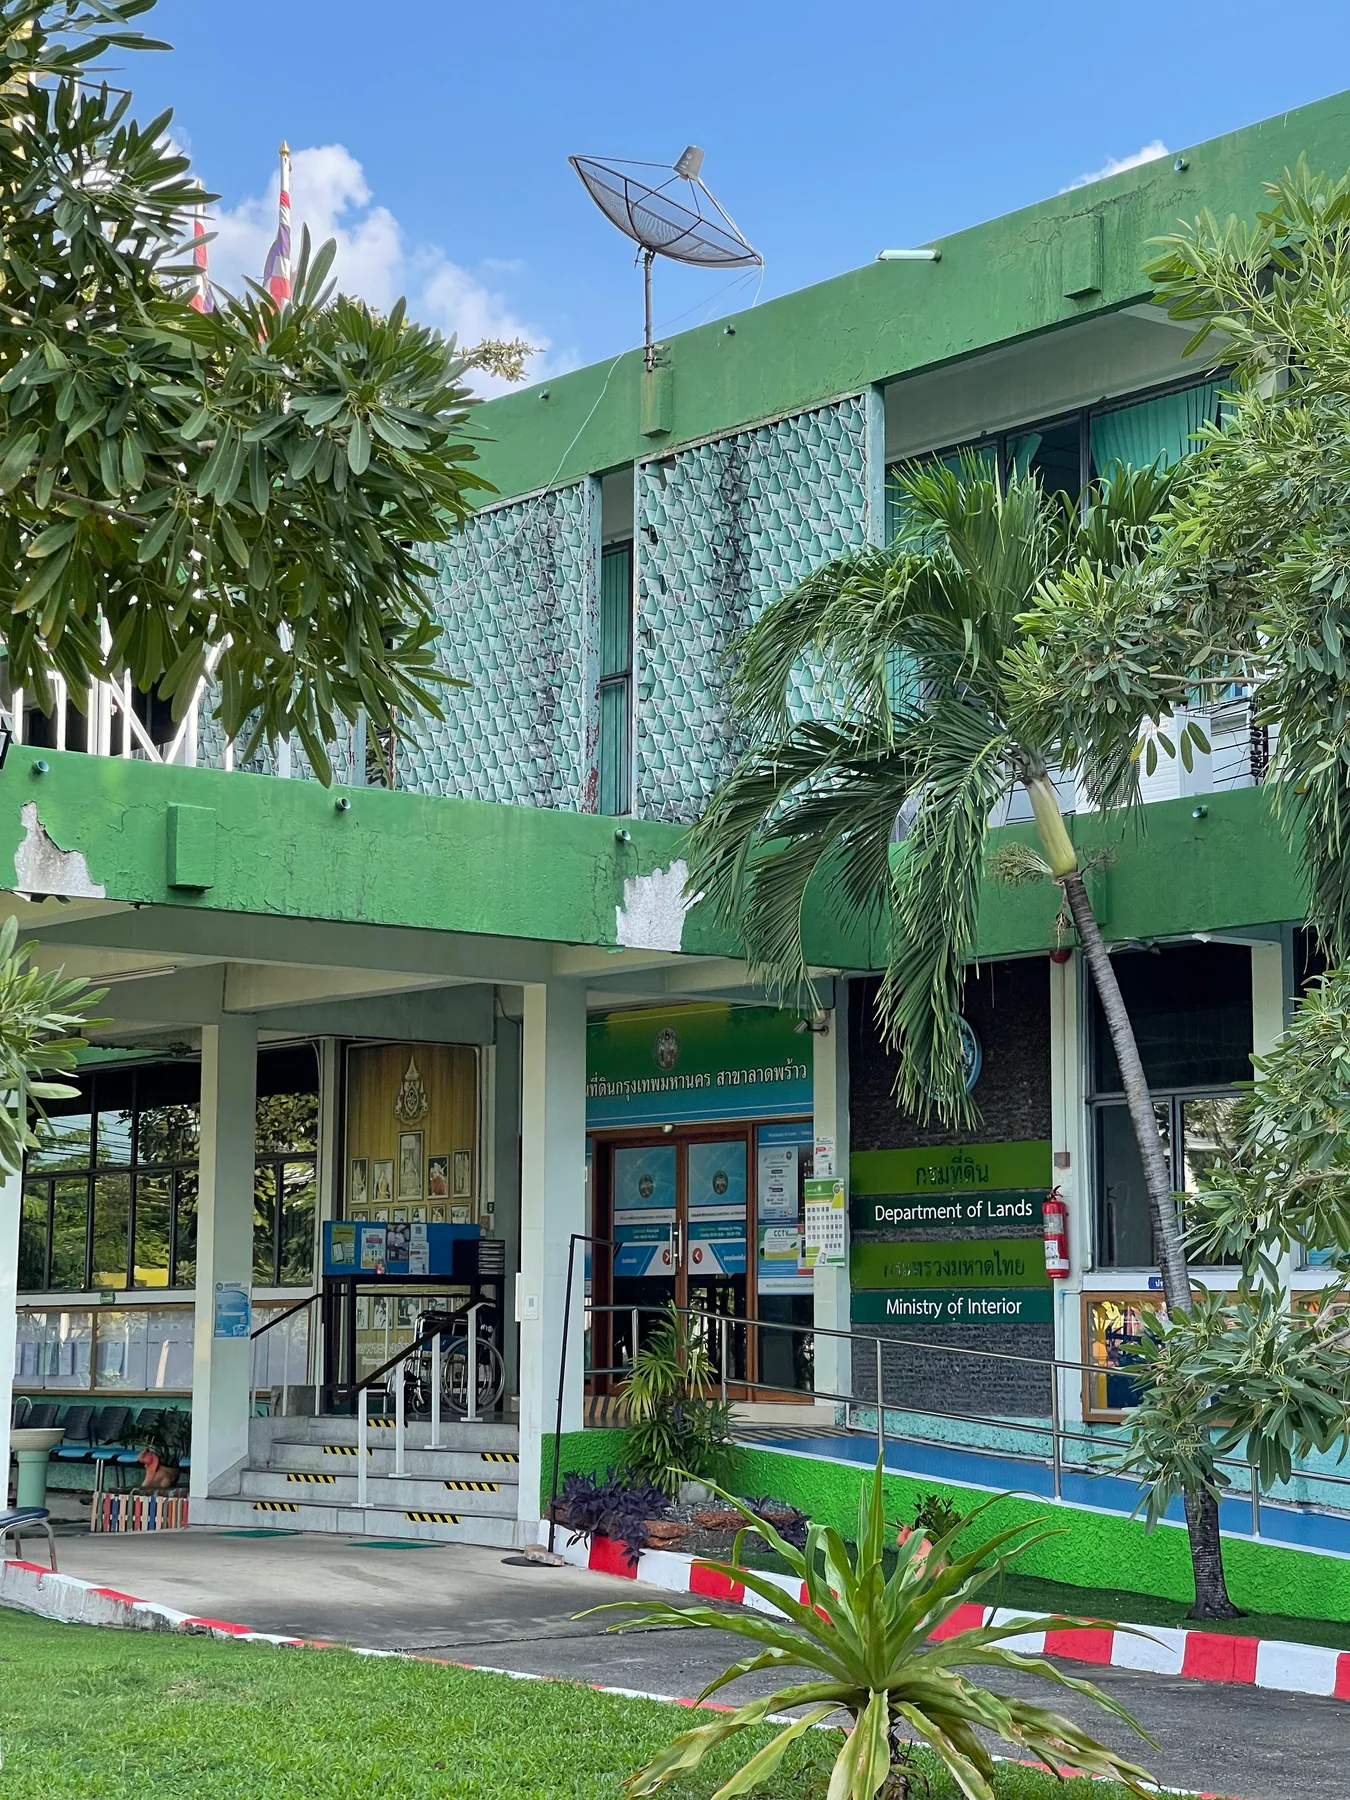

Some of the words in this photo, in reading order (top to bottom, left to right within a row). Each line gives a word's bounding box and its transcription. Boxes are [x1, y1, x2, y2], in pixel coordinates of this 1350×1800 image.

[716, 1058, 807, 1086] สาขาลาดพร้าว
[916, 1148, 989, 1186] กรมที่ดิน
[875, 1202, 962, 1224] Department
[967, 1200, 983, 1217] of
[988, 1199, 1033, 1217] Lands
[774, 1229, 789, 1237] CCTV
[886, 1298, 942, 1319] Ministry
[947, 1297, 964, 1315] of
[968, 1297, 1023, 1315] Interior
